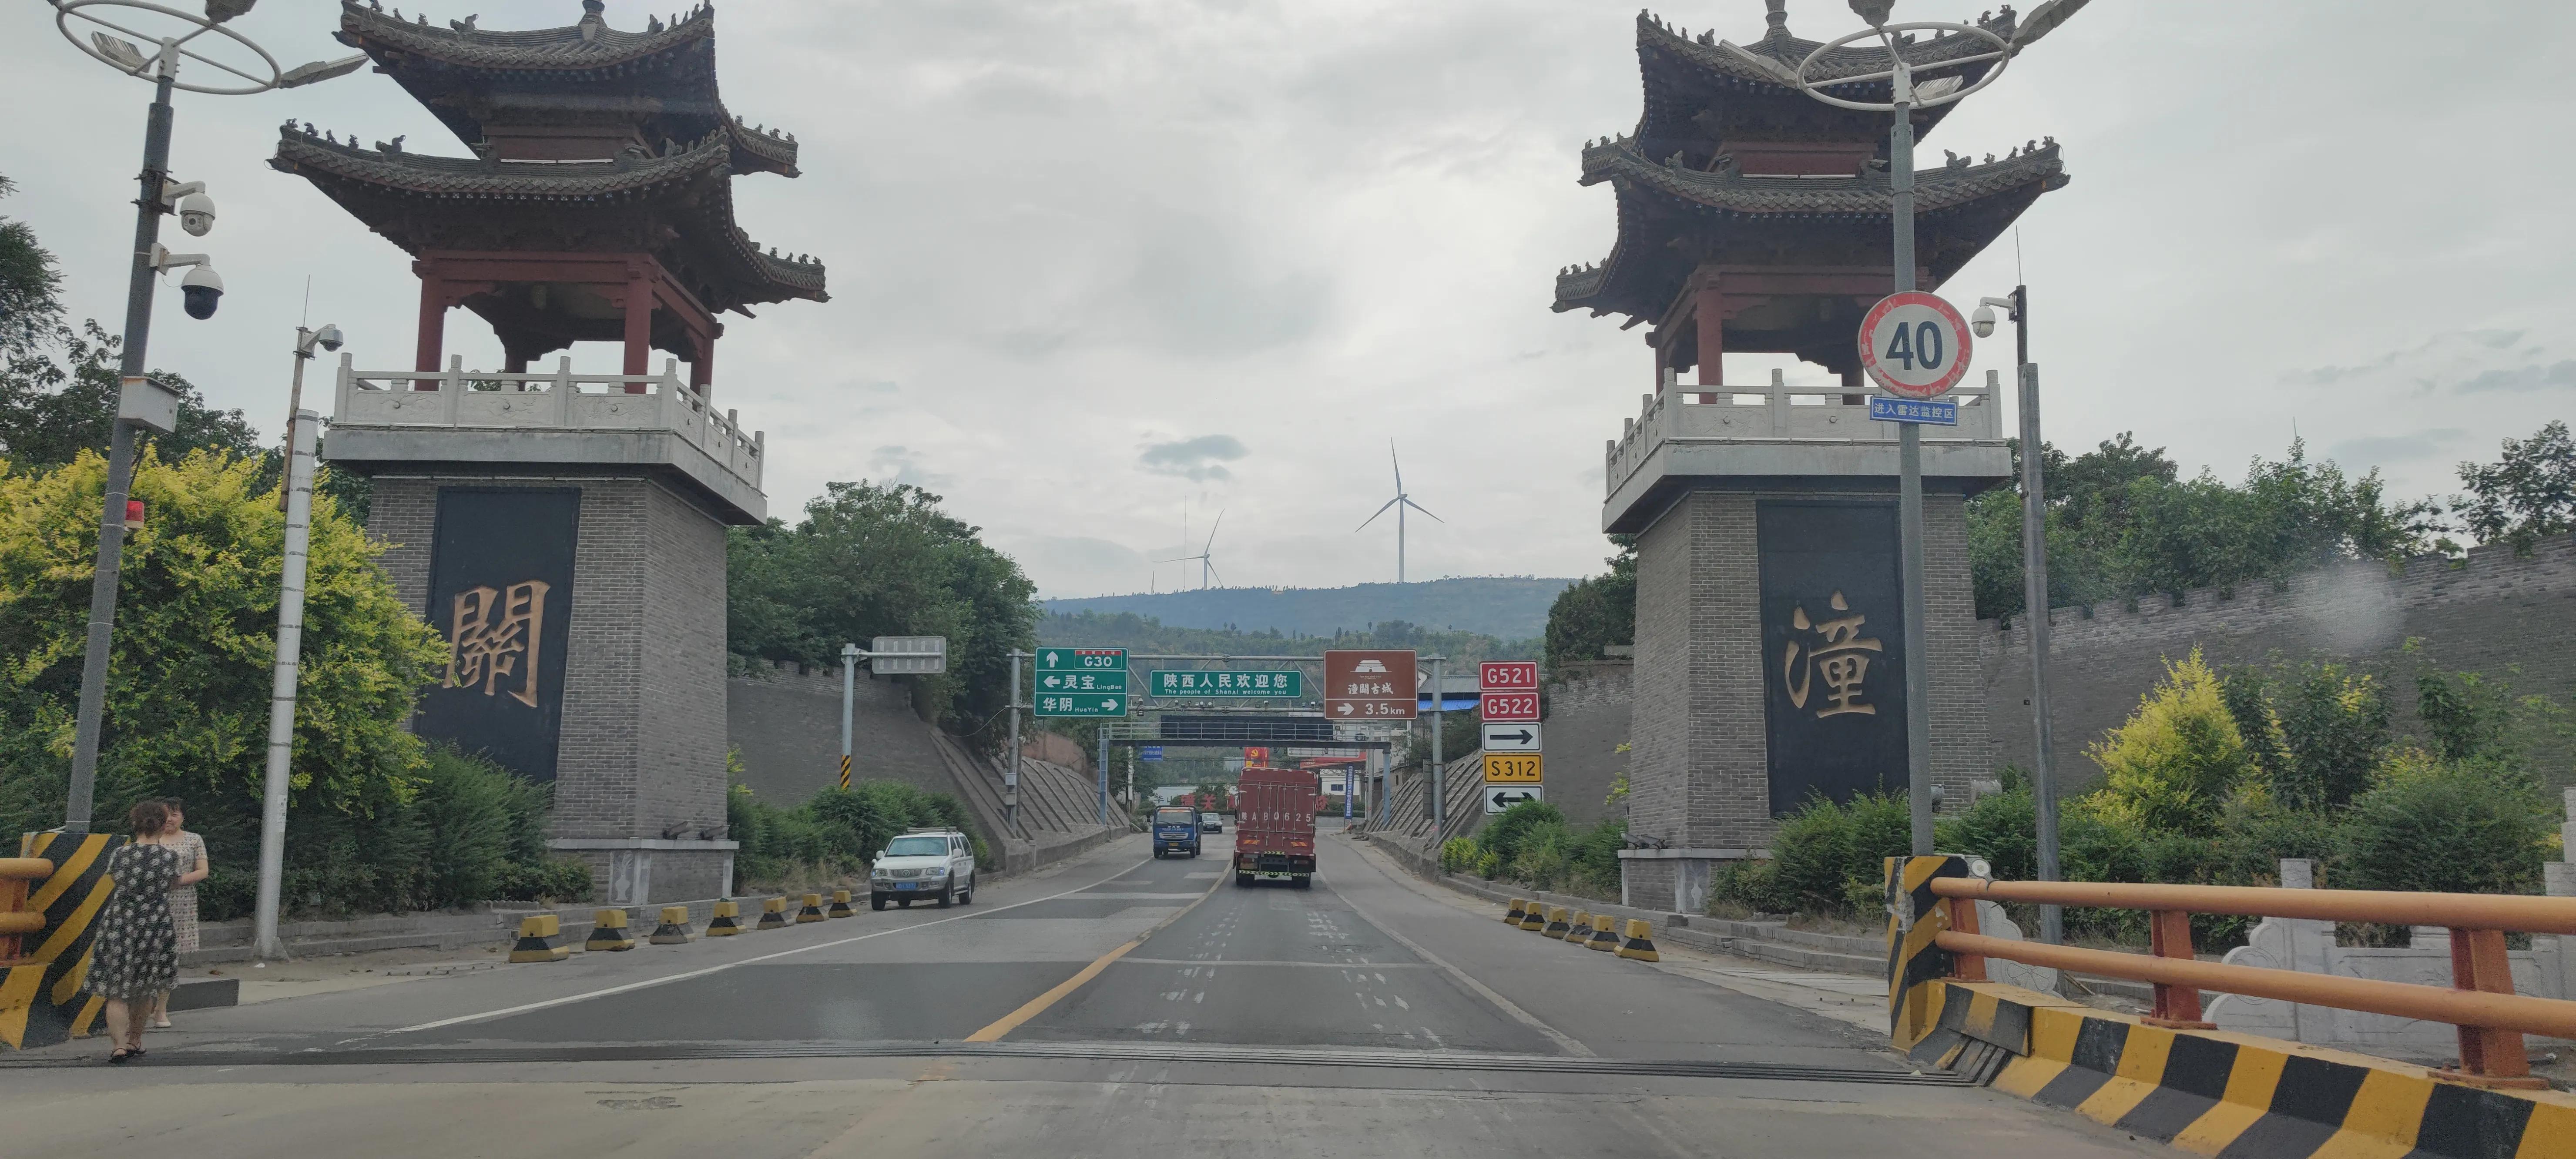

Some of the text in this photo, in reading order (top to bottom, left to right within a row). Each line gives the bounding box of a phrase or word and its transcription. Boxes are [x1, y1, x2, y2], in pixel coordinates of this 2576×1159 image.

[1885, 321, 1943, 370] 40
[1874, 403, 1954, 419] 进入雷达监控区
[443, 579, 550, 708] 關
[1085, 656, 1112, 667] G30
[1785, 590, 1882, 718] 潼
[1063, 675, 1095, 690] 灵宝
[1164, 673, 1288, 688] 陕西人民欢迎您
[1488, 668, 1530, 683] G521
[1043, 697, 1073, 712] 华阴
[1488, 698, 1533, 714] G522
[1492, 760, 1535, 777] S312
